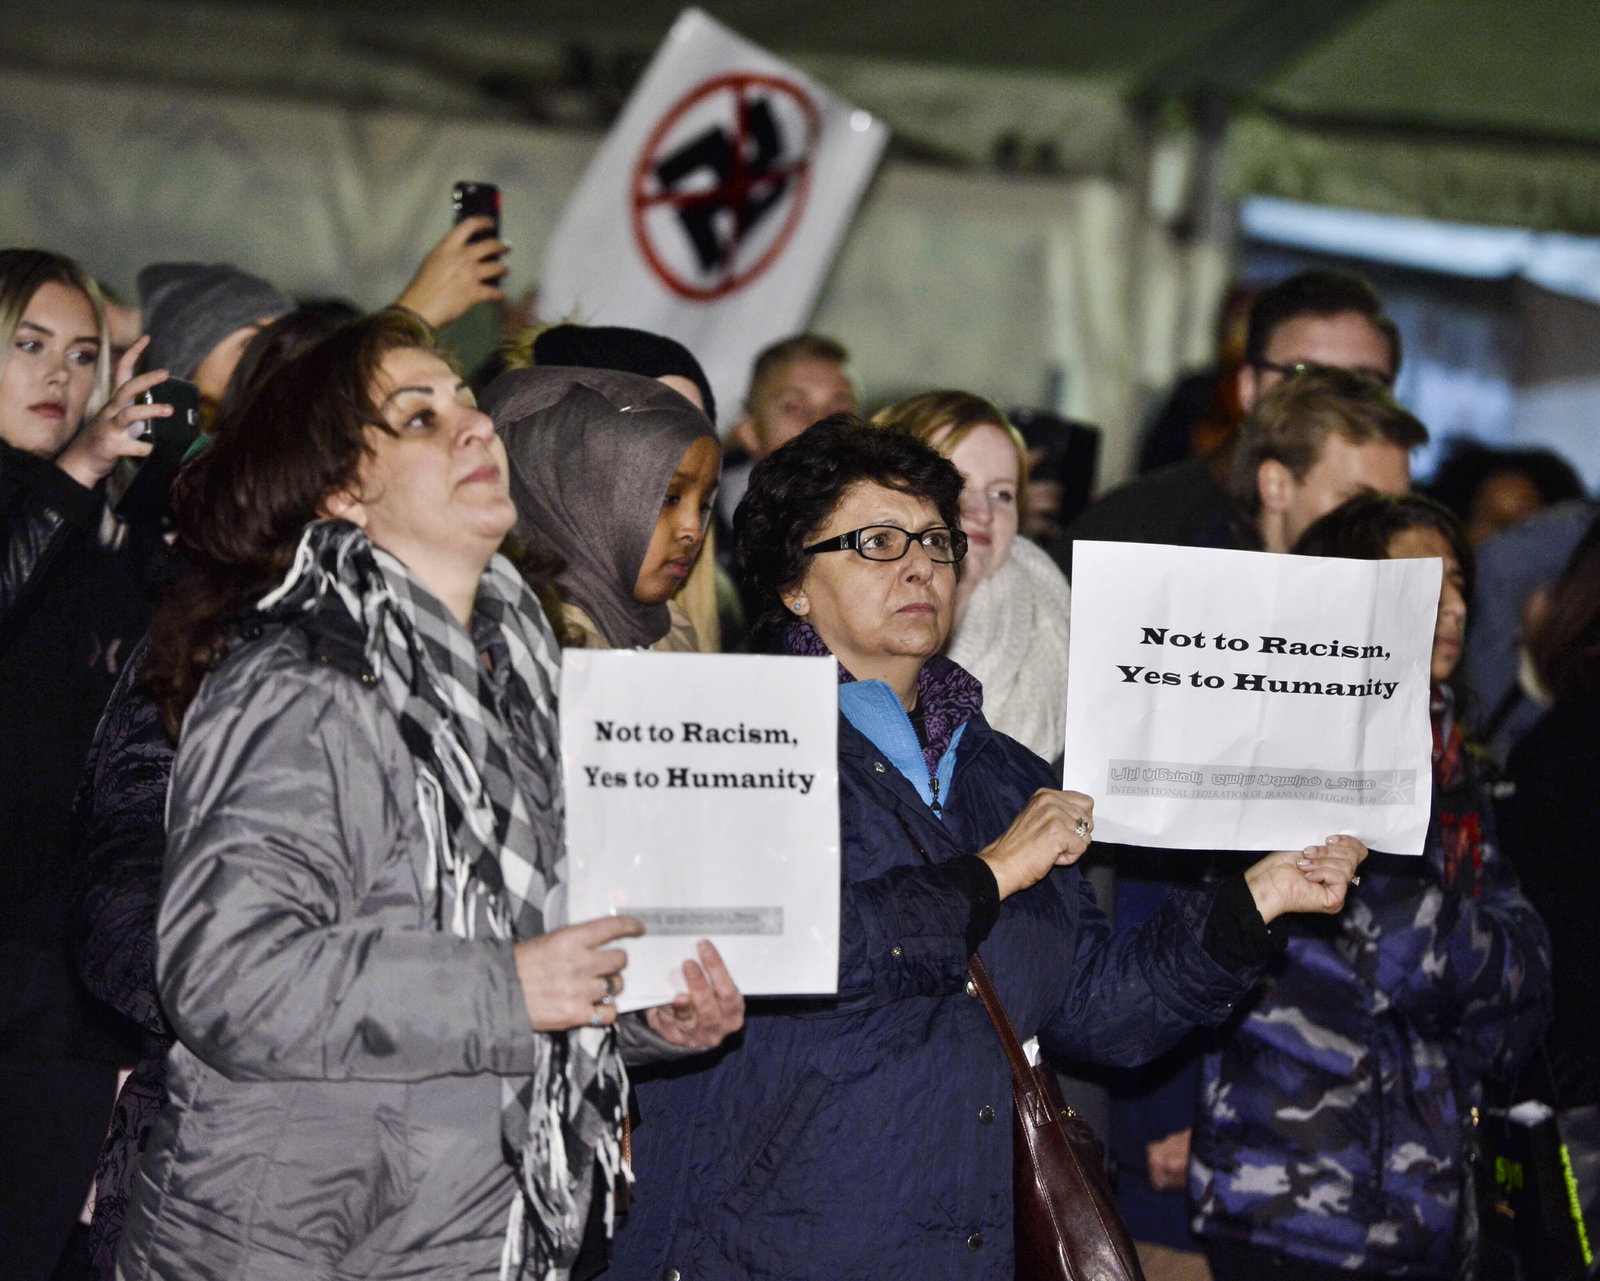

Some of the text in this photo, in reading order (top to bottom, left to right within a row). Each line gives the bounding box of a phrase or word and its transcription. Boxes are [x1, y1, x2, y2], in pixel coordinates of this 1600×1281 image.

[1139, 627, 1391, 661] Not to Racism,
[1116, 665, 1400, 700] Yes to Humanity
[595, 721, 798, 747] Not to Racism,
[584, 766, 815, 795] Yes to Humanity
[1111, 786, 1188, 798] INTERNATIONAL
[1192, 789, 1249, 799] FEDERATION
[1251, 790, 1263, 799] OF
[1265, 790, 1307, 800] IRANIAN
